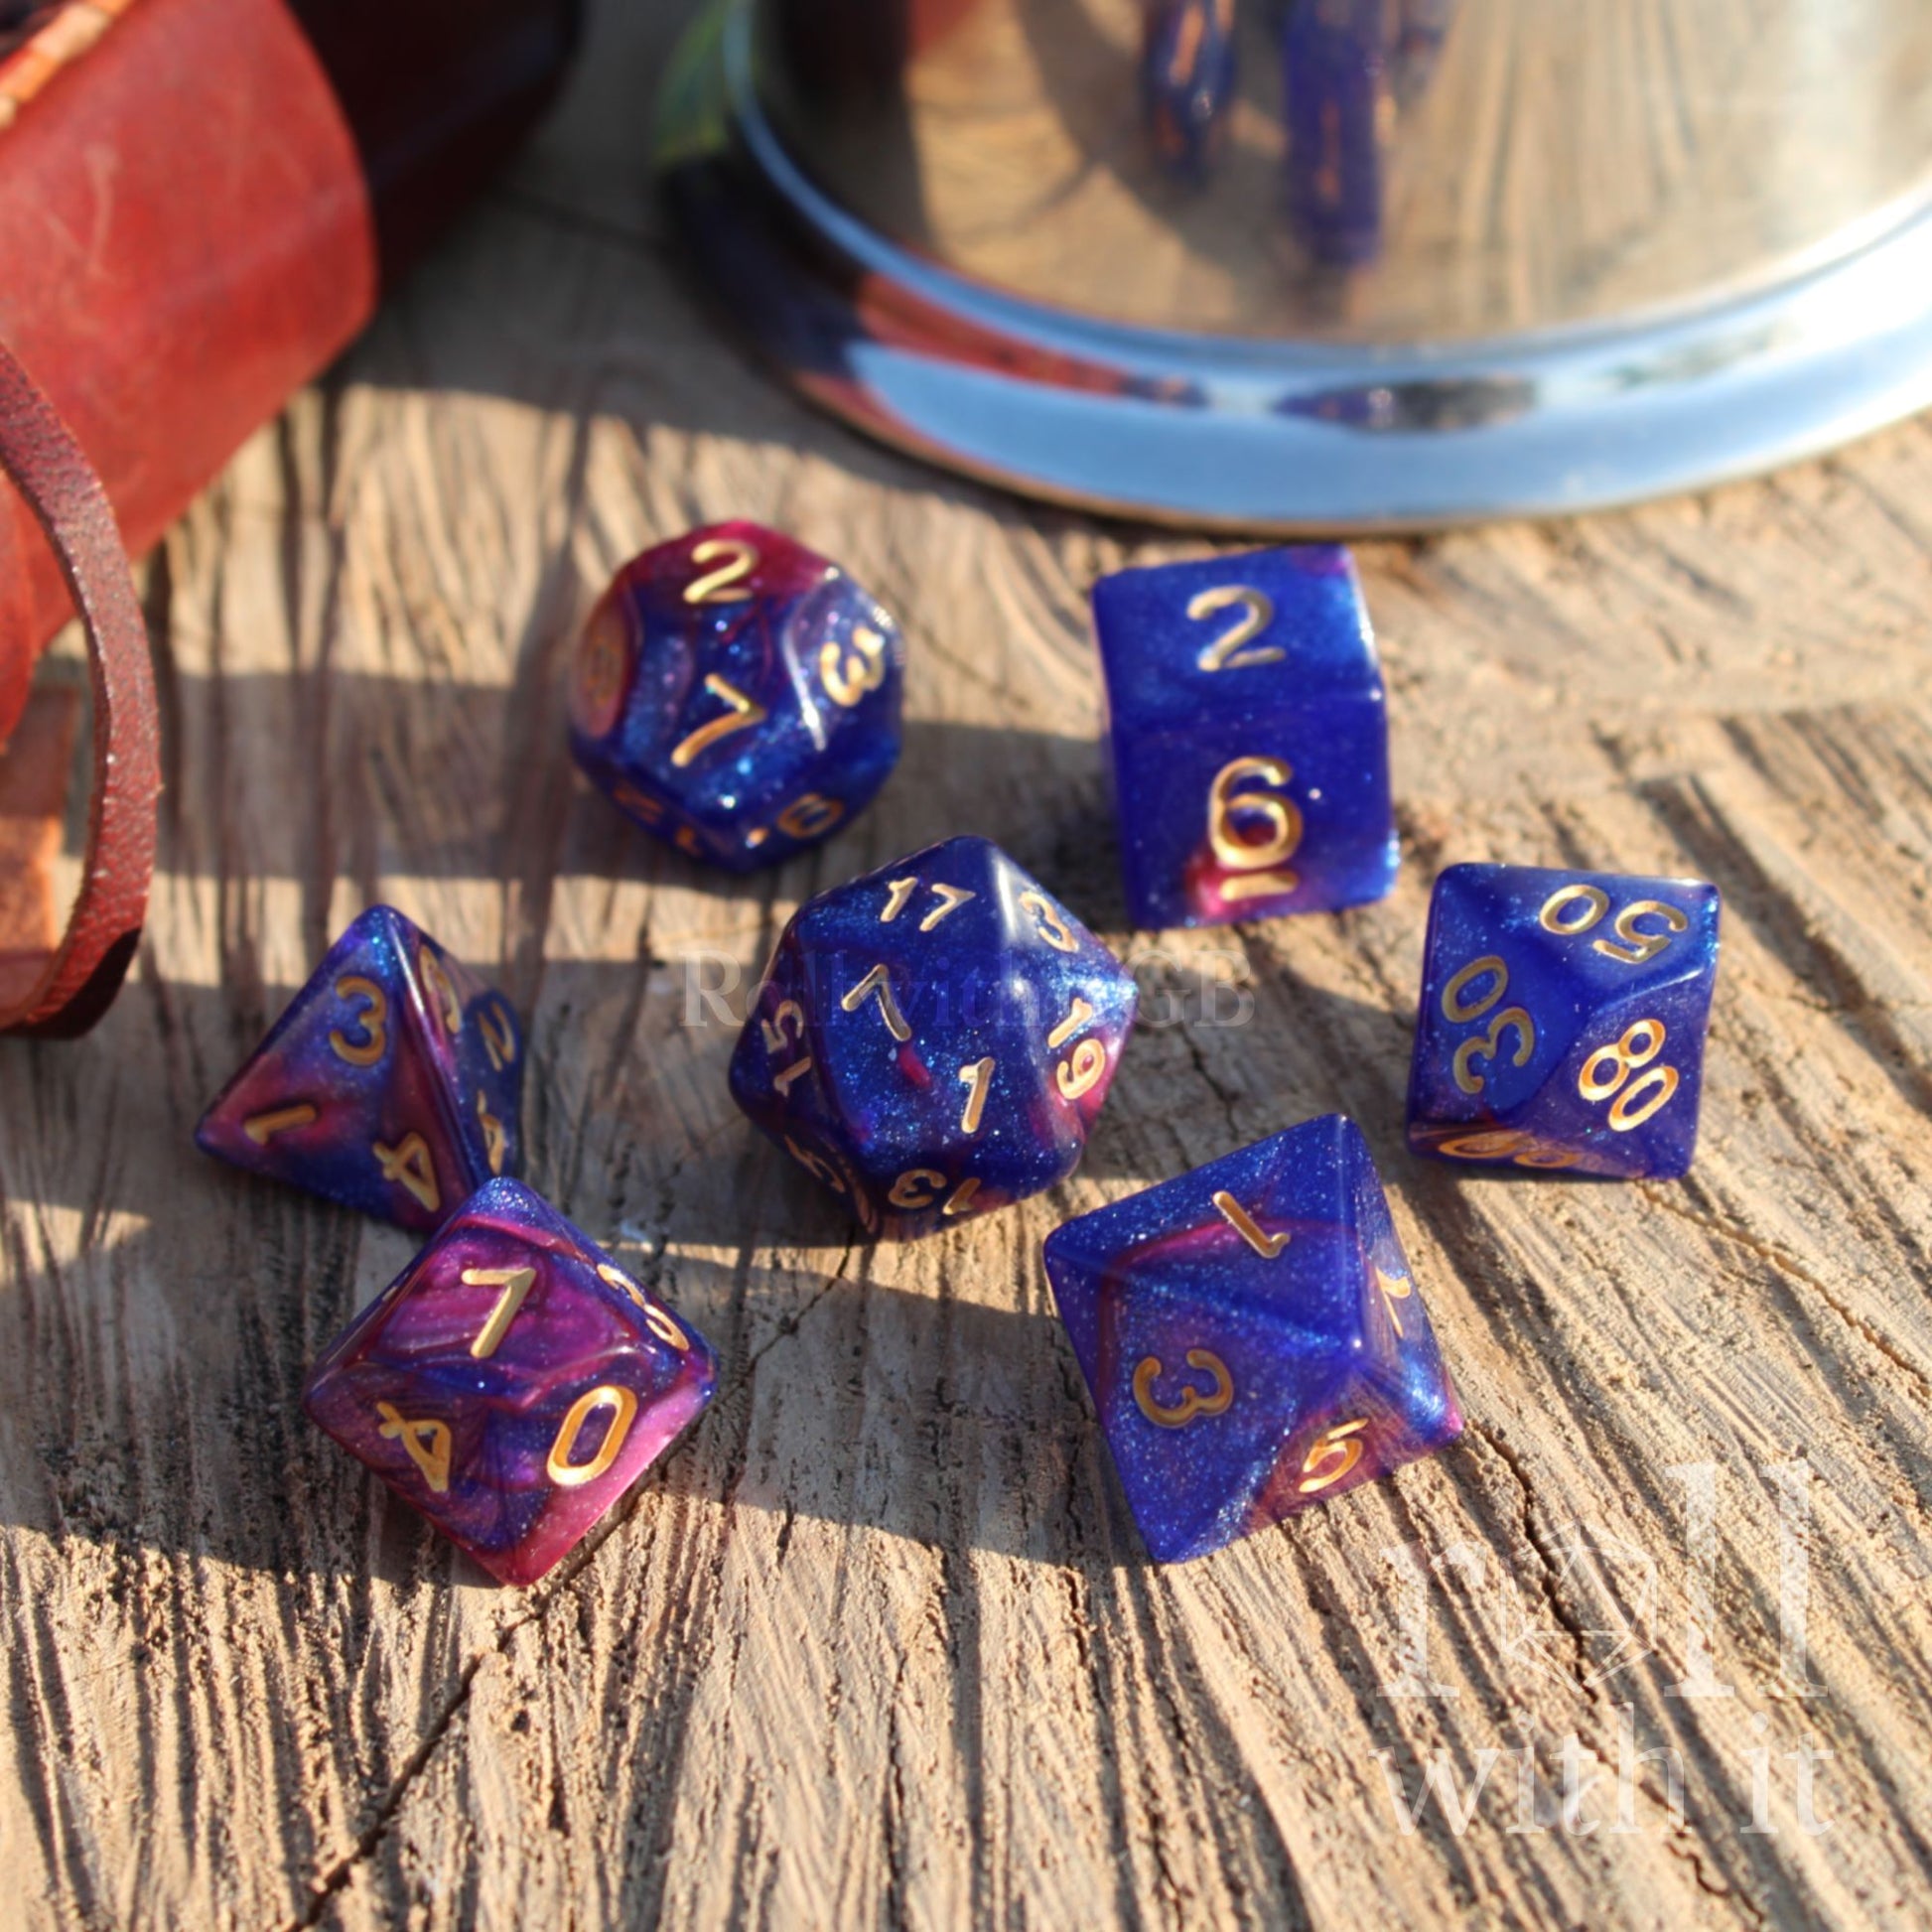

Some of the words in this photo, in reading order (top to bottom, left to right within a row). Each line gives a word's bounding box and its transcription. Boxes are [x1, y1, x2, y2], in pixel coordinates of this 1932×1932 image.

[683, 539, 758, 604] 2
[820, 626, 884, 707] 3
[1186, 585, 1286, 672] 2
[670, 672, 766, 765] 7
[1207, 755, 1304, 874] 6
[880, 877, 977, 932] 17
[1539, 884, 1689, 964] 50
[329, 975, 387, 1067] 3
[841, 964, 912, 1041] 7
[1442, 954, 1535, 1094] 30
[1047, 997, 1106, 1101] 19
[1578, 1018, 1680, 1133] 80
[242, 1103, 318, 1145] 1
[959, 1056, 996, 1135] 1
[372, 1130, 442, 1213] 4
[888, 1169, 982, 1215] 13
[1211, 1189, 1291, 1260] 1
[461, 1266, 537, 1359] 7
[1132, 1348, 1234, 1430] 3
[375, 1400, 453, 1493] 4
[546, 1385, 638, 1487] 0
[1298, 1417, 1369, 1494] 5
